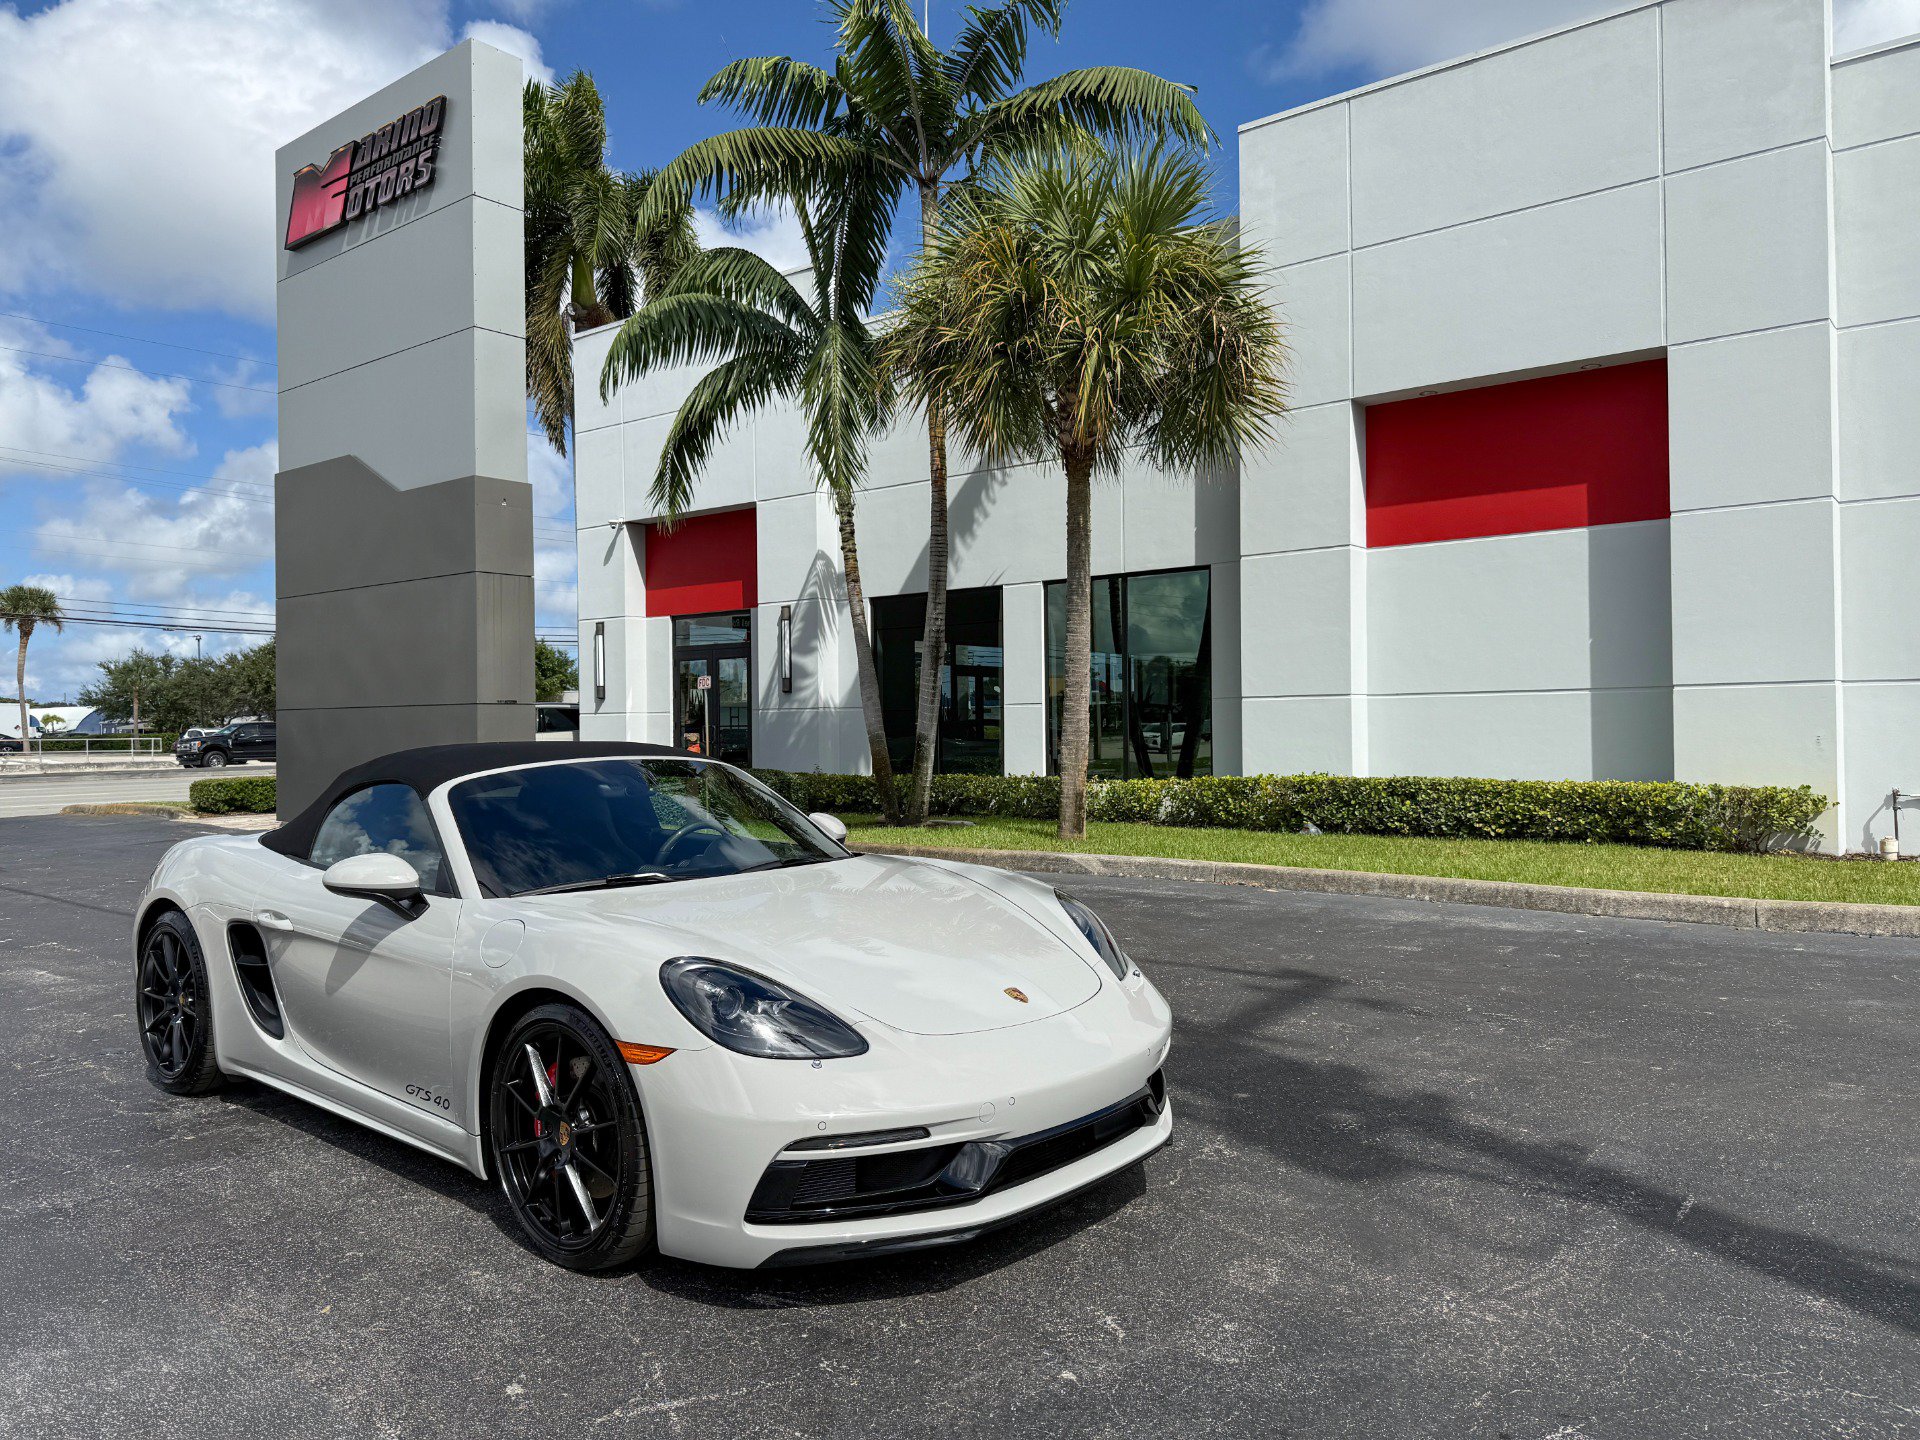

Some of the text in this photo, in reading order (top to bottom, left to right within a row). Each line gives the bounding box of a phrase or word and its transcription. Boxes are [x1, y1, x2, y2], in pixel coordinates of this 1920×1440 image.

[698, 677, 710, 687] FDC
[405, 1084, 451, 1111] GTS 4.0
